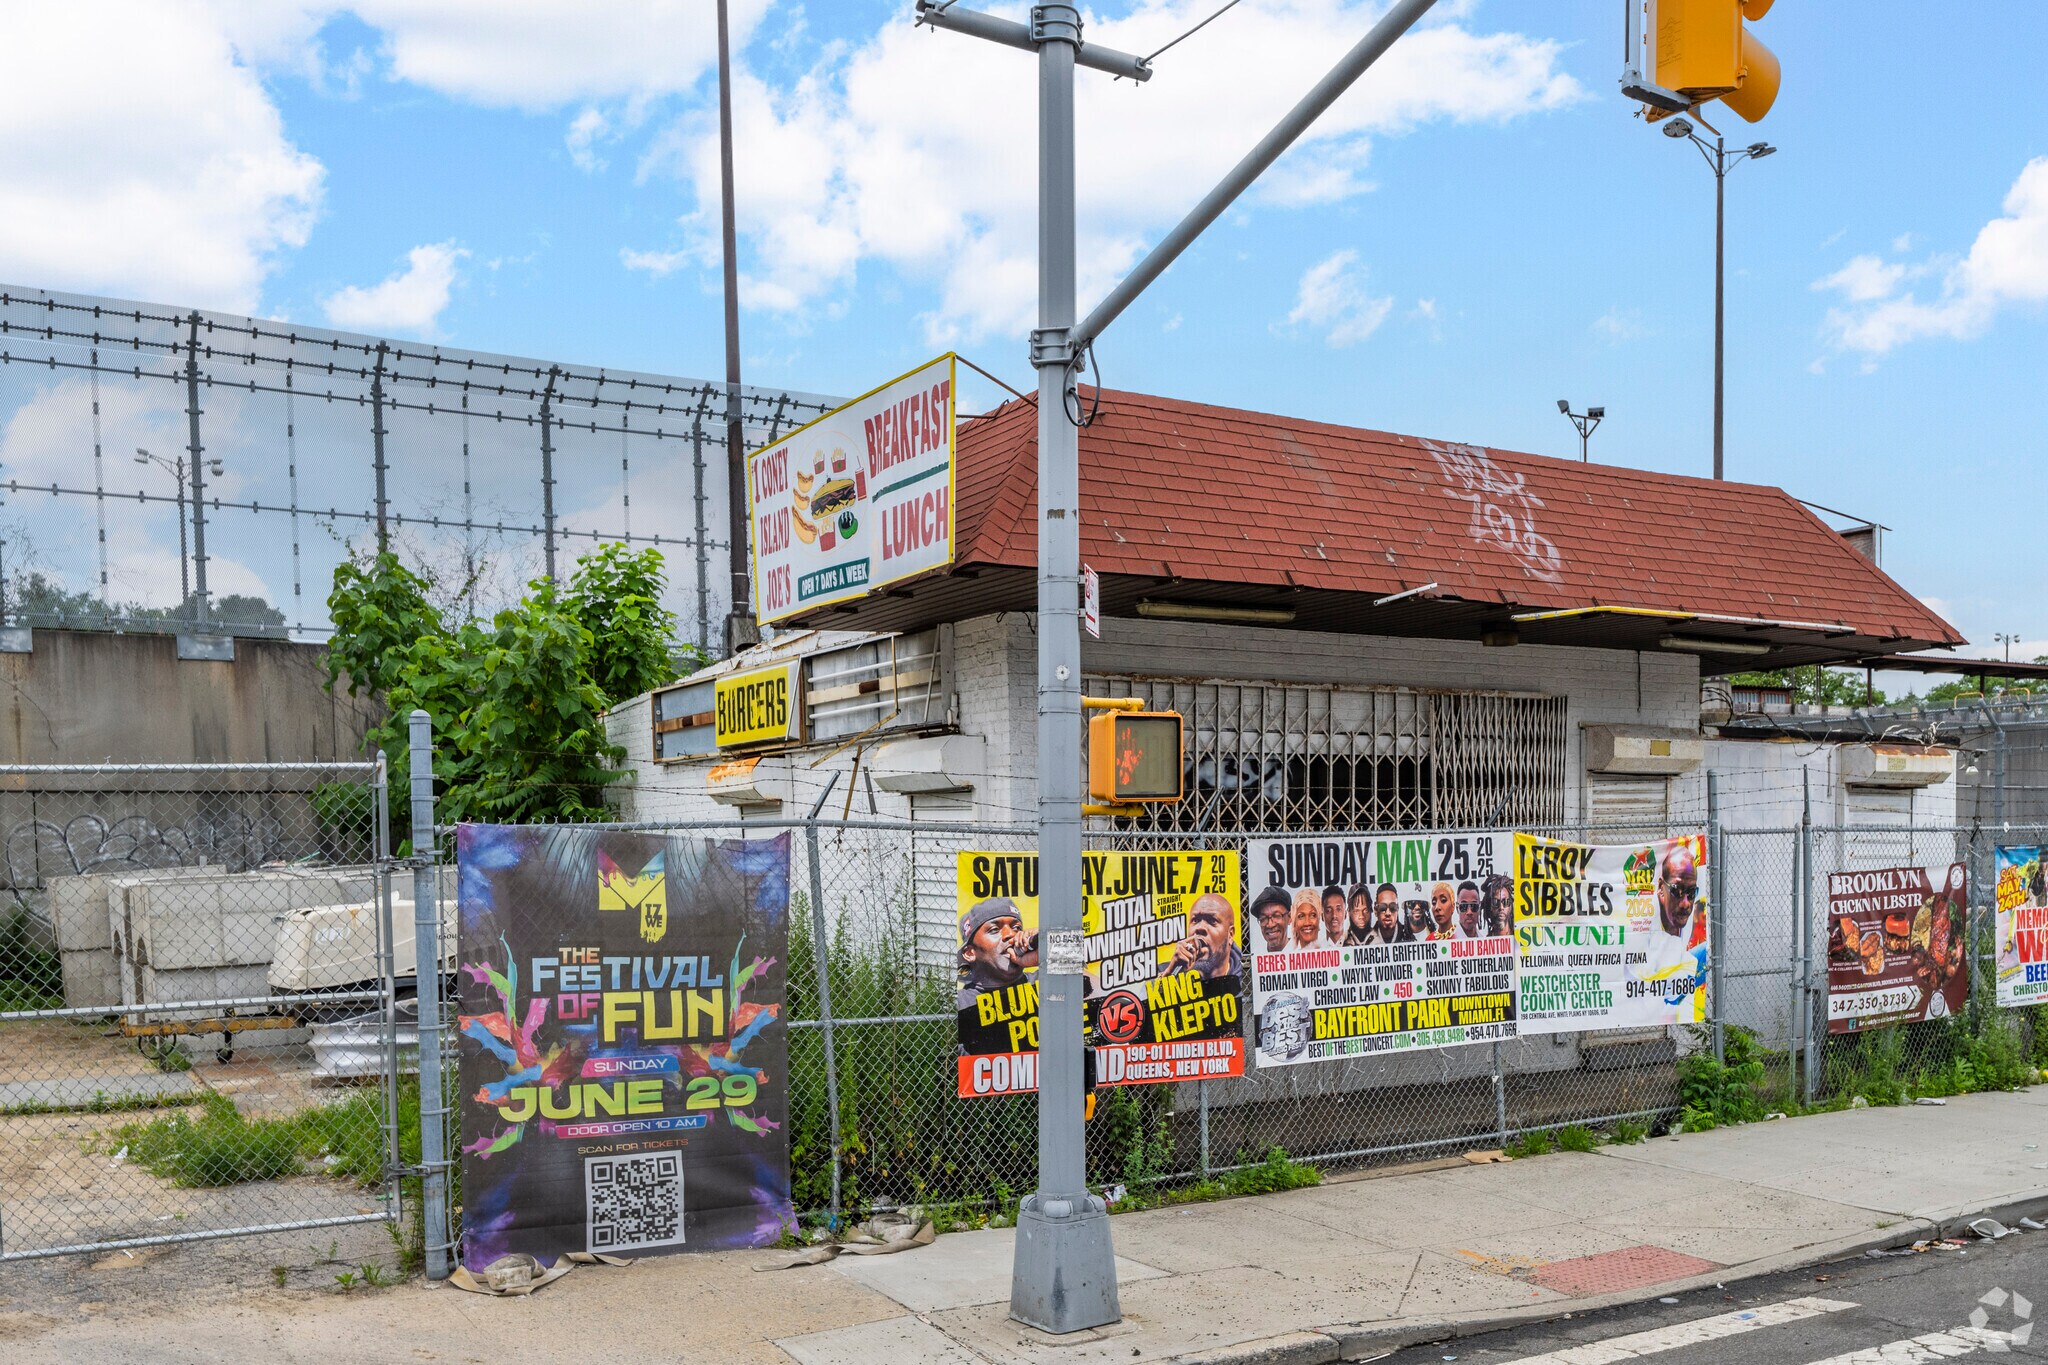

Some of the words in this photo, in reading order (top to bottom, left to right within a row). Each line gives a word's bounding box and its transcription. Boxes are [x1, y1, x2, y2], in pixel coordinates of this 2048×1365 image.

[864, 379, 950, 480] BREAKFAST
[762, 447, 788, 499] CONEY
[760, 506, 789, 557] ISLAND
[882, 485, 949, 561] LUNCH
[766, 562, 791, 612] JOE'S
[802, 577, 814, 597] OPEN
[815, 575, 820, 592] 7
[821, 569, 838, 590] DAYS
[839, 568, 845, 586] A
[846, 563, 867, 584] WEEK
[717, 677, 787, 737] BURGERS
[1477, 837, 1492, 856] 20
[1211, 855, 1226, 874] 20
[1478, 858, 1493, 878] 25
[1519, 844, 1596, 881] LEROY
[2000, 864, 2018, 883] SAT
[1211, 875, 1226, 894] 25
[1830, 869, 1921, 895] BROOKLYN
[1997, 876, 2022, 899] MAY
[1157, 894, 1181, 905] STRAIGHT
[1160, 902, 1182, 917] WAR!!
[1520, 882, 1613, 917] SIBBLES
[1625, 898, 1655, 917] 2025
[1830, 898, 1870, 915] CHCKN
[1871, 897, 1881, 911] N
[1883, 893, 1923, 910] LBSTR
[1998, 889, 2027, 913] 24TH
[1103, 894, 1156, 931] TOTAL
[1084, 915, 1186, 962] NNIHILATION
[1519, 925, 1555, 947] SUN
[1559, 925, 1615, 946] JUNE
[559, 947, 600, 964] THE
[1257, 956, 1286, 973] BERES
[1289, 950, 1340, 970] HAMMOND
[1354, 947, 1390, 965] MARCIA
[1393, 943, 1437, 963] GRIFFITHS
[1451, 940, 1474, 958] BUJU
[1477, 938, 1511, 955] BANTON
[1520, 955, 1564, 968] YELLOWMAN
[1568, 954, 1592, 966] QUEEN
[1595, 953, 1621, 966] IFRICA
[1625, 952, 1648, 965] ETANA
[532, 956, 723, 992] FESTIVAL
[1101, 949, 1157, 990] CLASH
[1260, 974, 1299, 992] ROMAIN
[1301, 970, 1328, 988] VIRGO
[1341, 967, 1373, 985] WAYNE
[1375, 963, 1413, 982] WONDER
[1426, 961, 1460, 978] NADINE
[1461, 956, 1514, 975] SUTHERLAND
[1145, 969, 1203, 1011] KING
[1314, 988, 1356, 1006] CHRONIC
[1359, 985, 1379, 1002] LAW
[1394, 982, 1412, 999] 450
[1427, 979, 1462, 996] SKINNY
[1465, 974, 1509, 993] FABULOUS
[1520, 973, 1600, 993] WESTCHESTER
[1626, 978, 1695, 998] 914-417-1686
[975, 980, 1039, 1027] BLUN
[1452, 993, 1511, 1012] DOWNTOWN
[1520, 993, 1567, 1012] COUNTY
[1571, 990, 1613, 1010] CENTER
[1832, 992, 1907, 1013] 347-350-8738
[557, 993, 601, 1019] OF
[603, 989, 724, 1042] FUN
[1151, 993, 1237, 1043] KLEPTO
[1314, 1002, 1402, 1040] BAYFRONT
[1407, 999, 1451, 1030] PARK
[1458, 1008, 1505, 1025] MIAMI.FL
[1529, 1012, 1547, 1020] CENTRAL
[1557, 1010, 1569, 1018] WHITE
[1127, 1045, 1162, 1062] 190-01
[1165, 1043, 1205, 1060] LINDEN
[1207, 1041, 1236, 1057] BLVD,
[1308, 1033, 1411, 1059] BESTOFTHEBESTCONCERT.COM
[1416, 1028, 1466, 1047] 305.438.9488
[1470, 1022, 1517, 1041] 954.470.7666
[594, 1058, 667, 1073] SUNDAY
[1126, 1063, 1174, 1081] QUEENS,
[1176, 1060, 1200, 1073] NEW
[1202, 1058, 1230, 1073] YORK
[498, 1080, 664, 1123] JUNE
[686, 1074, 757, 1110] 29
[567, 1124, 609, 1137] DOOR
[613, 1121, 650, 1134] OPEN
[655, 1120, 669, 1130] 10
[675, 1118, 697, 1129] AM
[577, 1146, 613, 1154] SCAN
[616, 1143, 638, 1151] FOR
[642, 1138, 689, 1149] TICKETS
